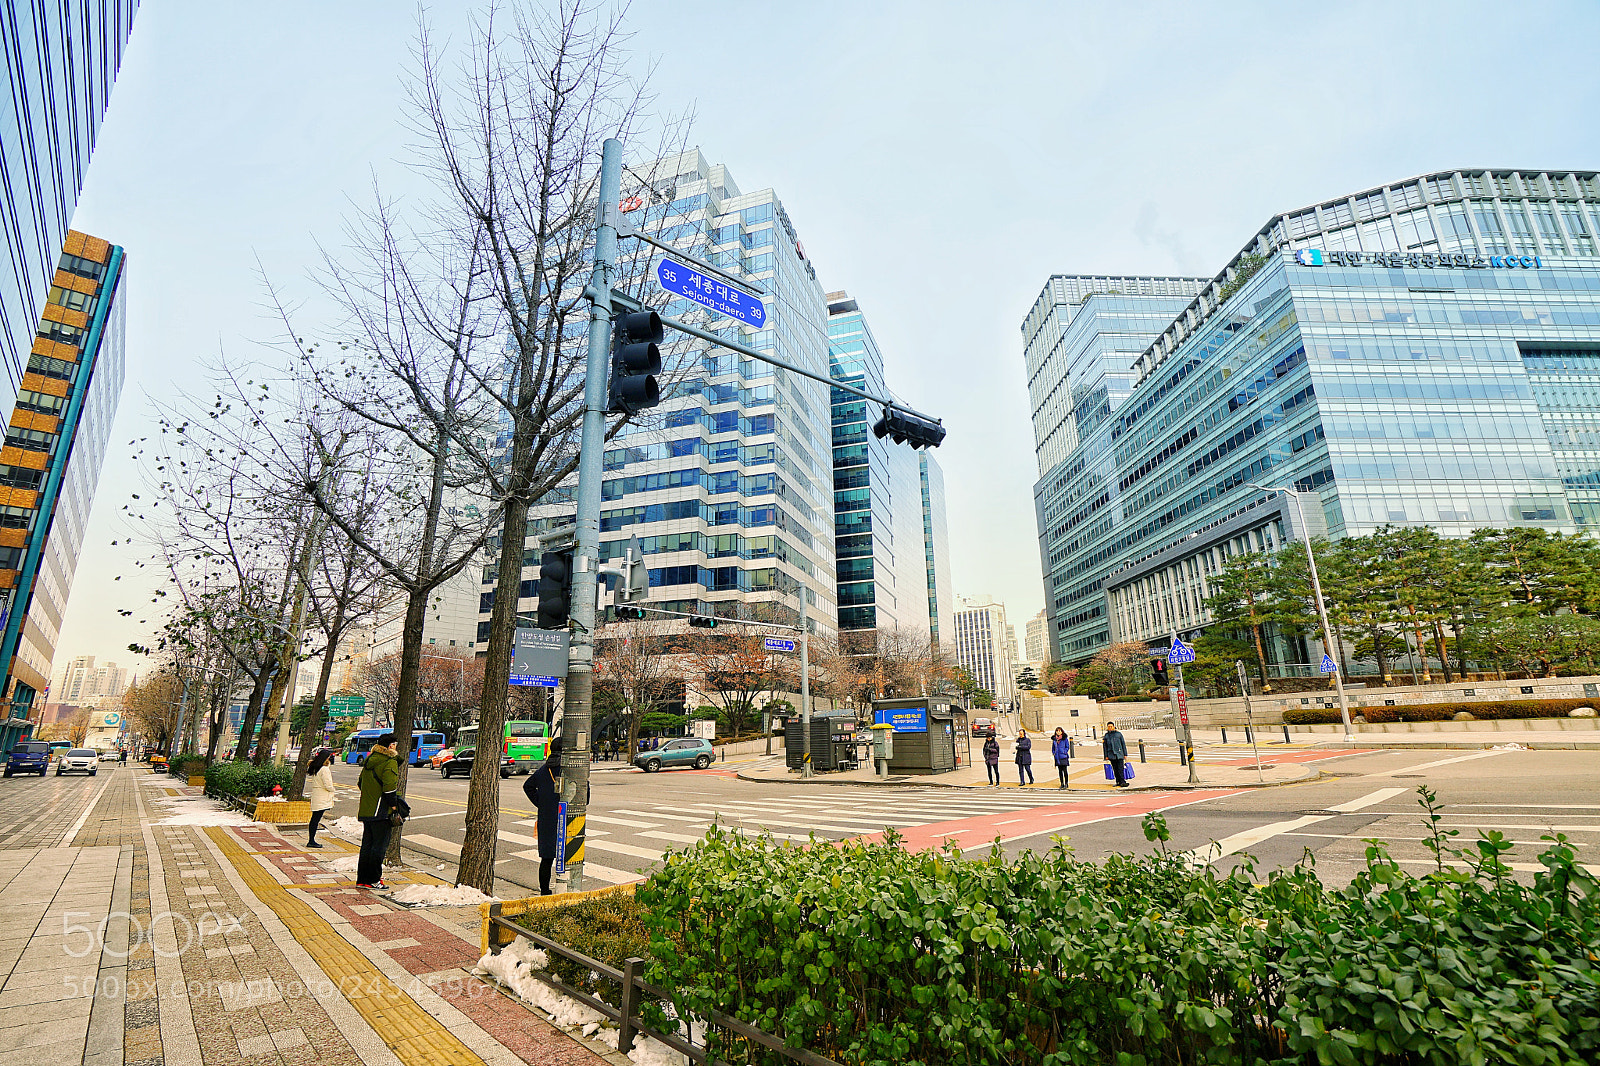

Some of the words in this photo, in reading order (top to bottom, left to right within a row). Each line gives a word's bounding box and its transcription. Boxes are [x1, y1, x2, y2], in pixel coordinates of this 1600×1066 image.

[1490, 255, 1543, 269] KCCI
[662, 268, 677, 283] 35
[688, 273, 741, 306] 세종대로
[682, 285, 746, 319] Sejong-daero
[750, 306, 762, 319] 39
